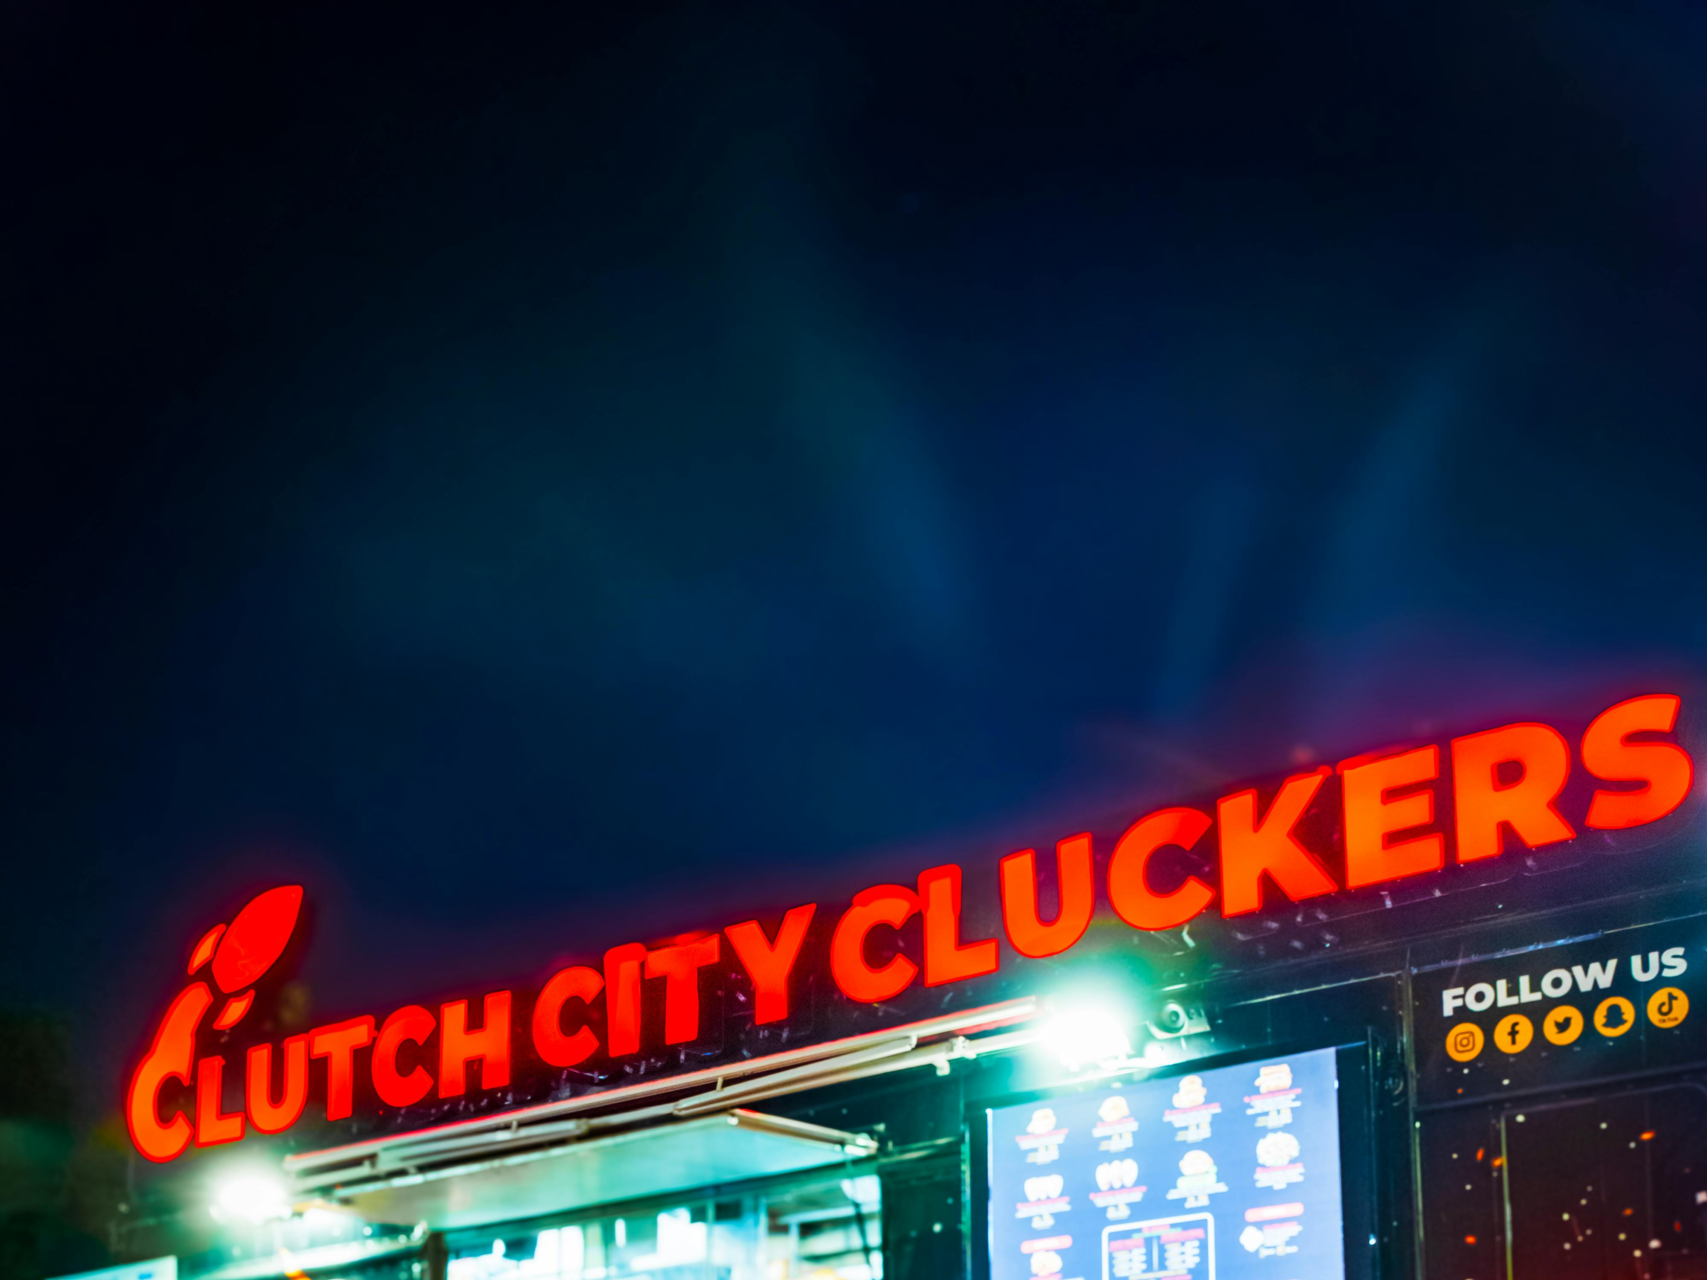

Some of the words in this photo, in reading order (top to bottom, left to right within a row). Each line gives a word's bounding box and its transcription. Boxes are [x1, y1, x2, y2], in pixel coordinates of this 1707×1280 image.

[127, 981, 512, 1163] CLUTCH
[531, 902, 818, 1060] CITY
[830, 693, 1694, 1003] CLUCKERS
[1442, 958, 1618, 1017] FOLLOW
[1630, 947, 1688, 982] US
